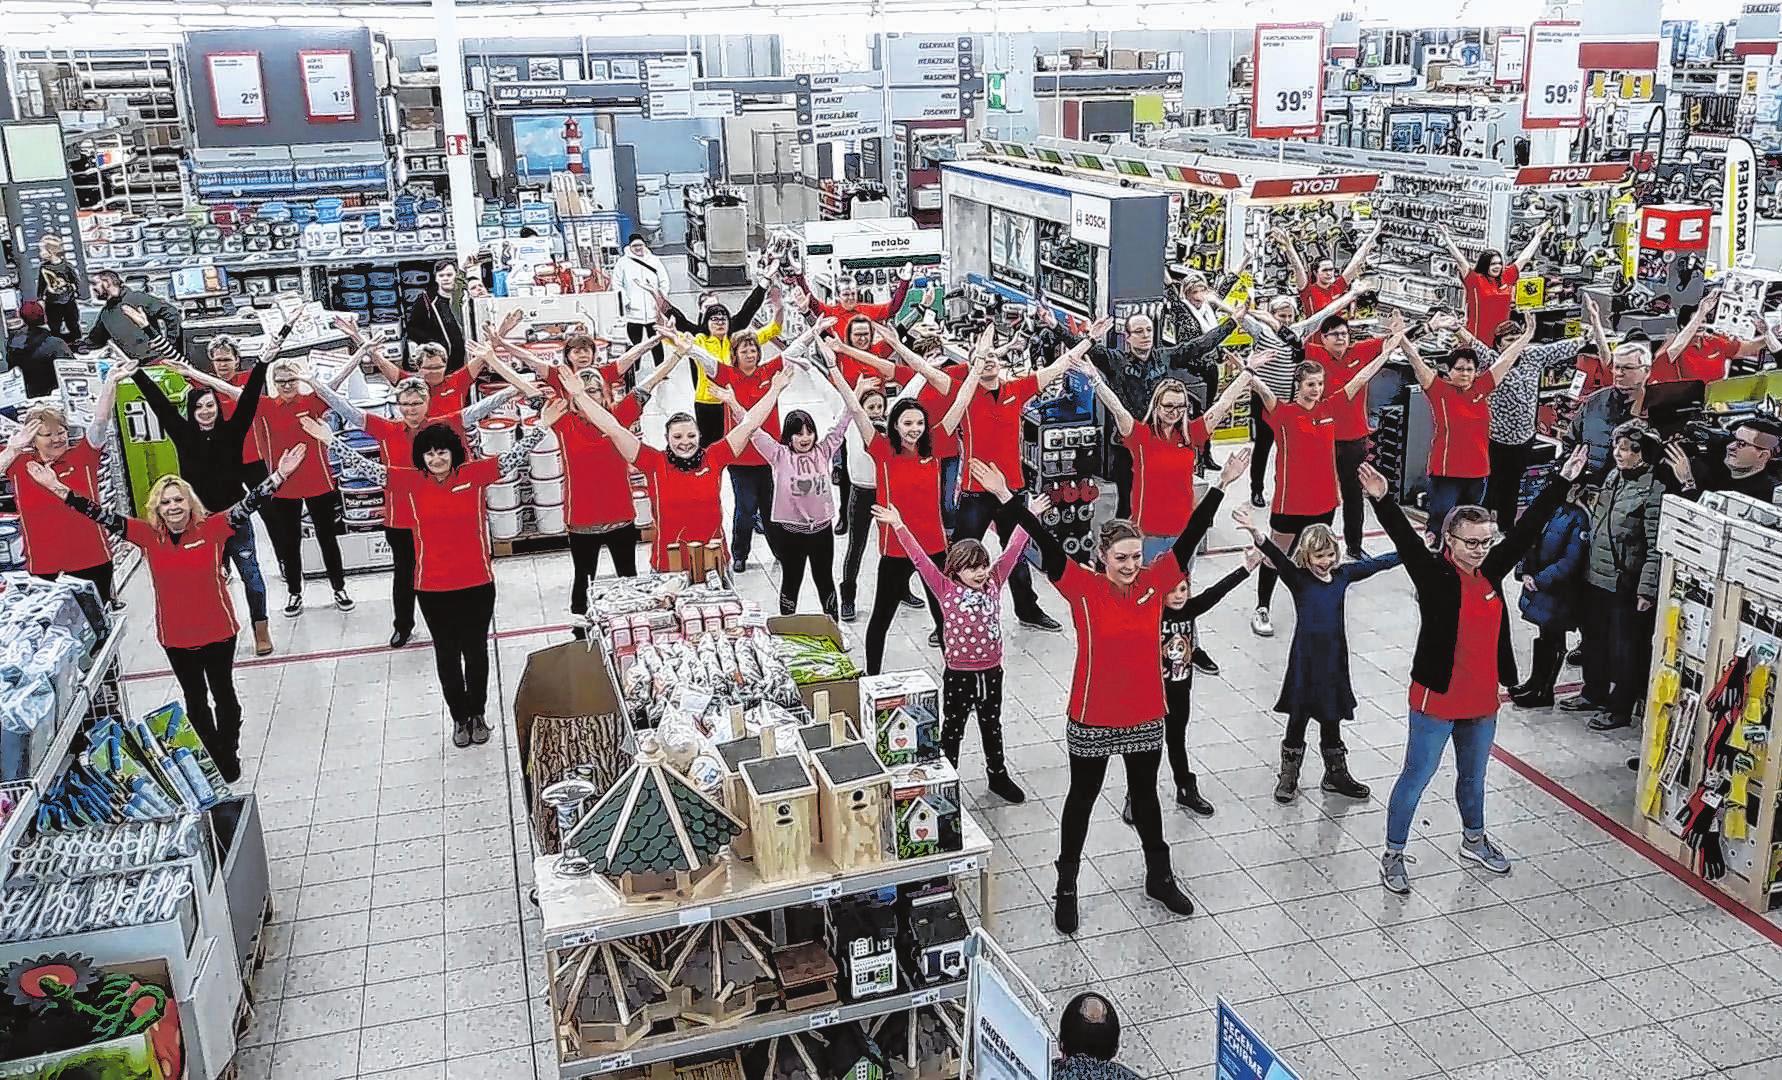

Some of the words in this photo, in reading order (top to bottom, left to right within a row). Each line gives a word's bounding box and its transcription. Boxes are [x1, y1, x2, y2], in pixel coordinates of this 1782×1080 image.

[813, 77, 840, 85] GARTEN
[923, 73, 956, 81] MASCHINE
[500, 87, 519, 97] BAD
[520, 87, 567, 98] GESTALTEN
[814, 96, 843, 105] PFLANZE
[816, 129, 849, 139] HAUSHALT
[1549, 167, 1591, 183] RYOBI
[1290, 178, 1340, 194] RYOBI
[1084, 214, 1107, 230] BOSCH
[871, 236, 910, 247] metabo
[1223, 1015, 1257, 1056] REGEN-
[1223, 1028, 1263, 1080] SCHIRME
